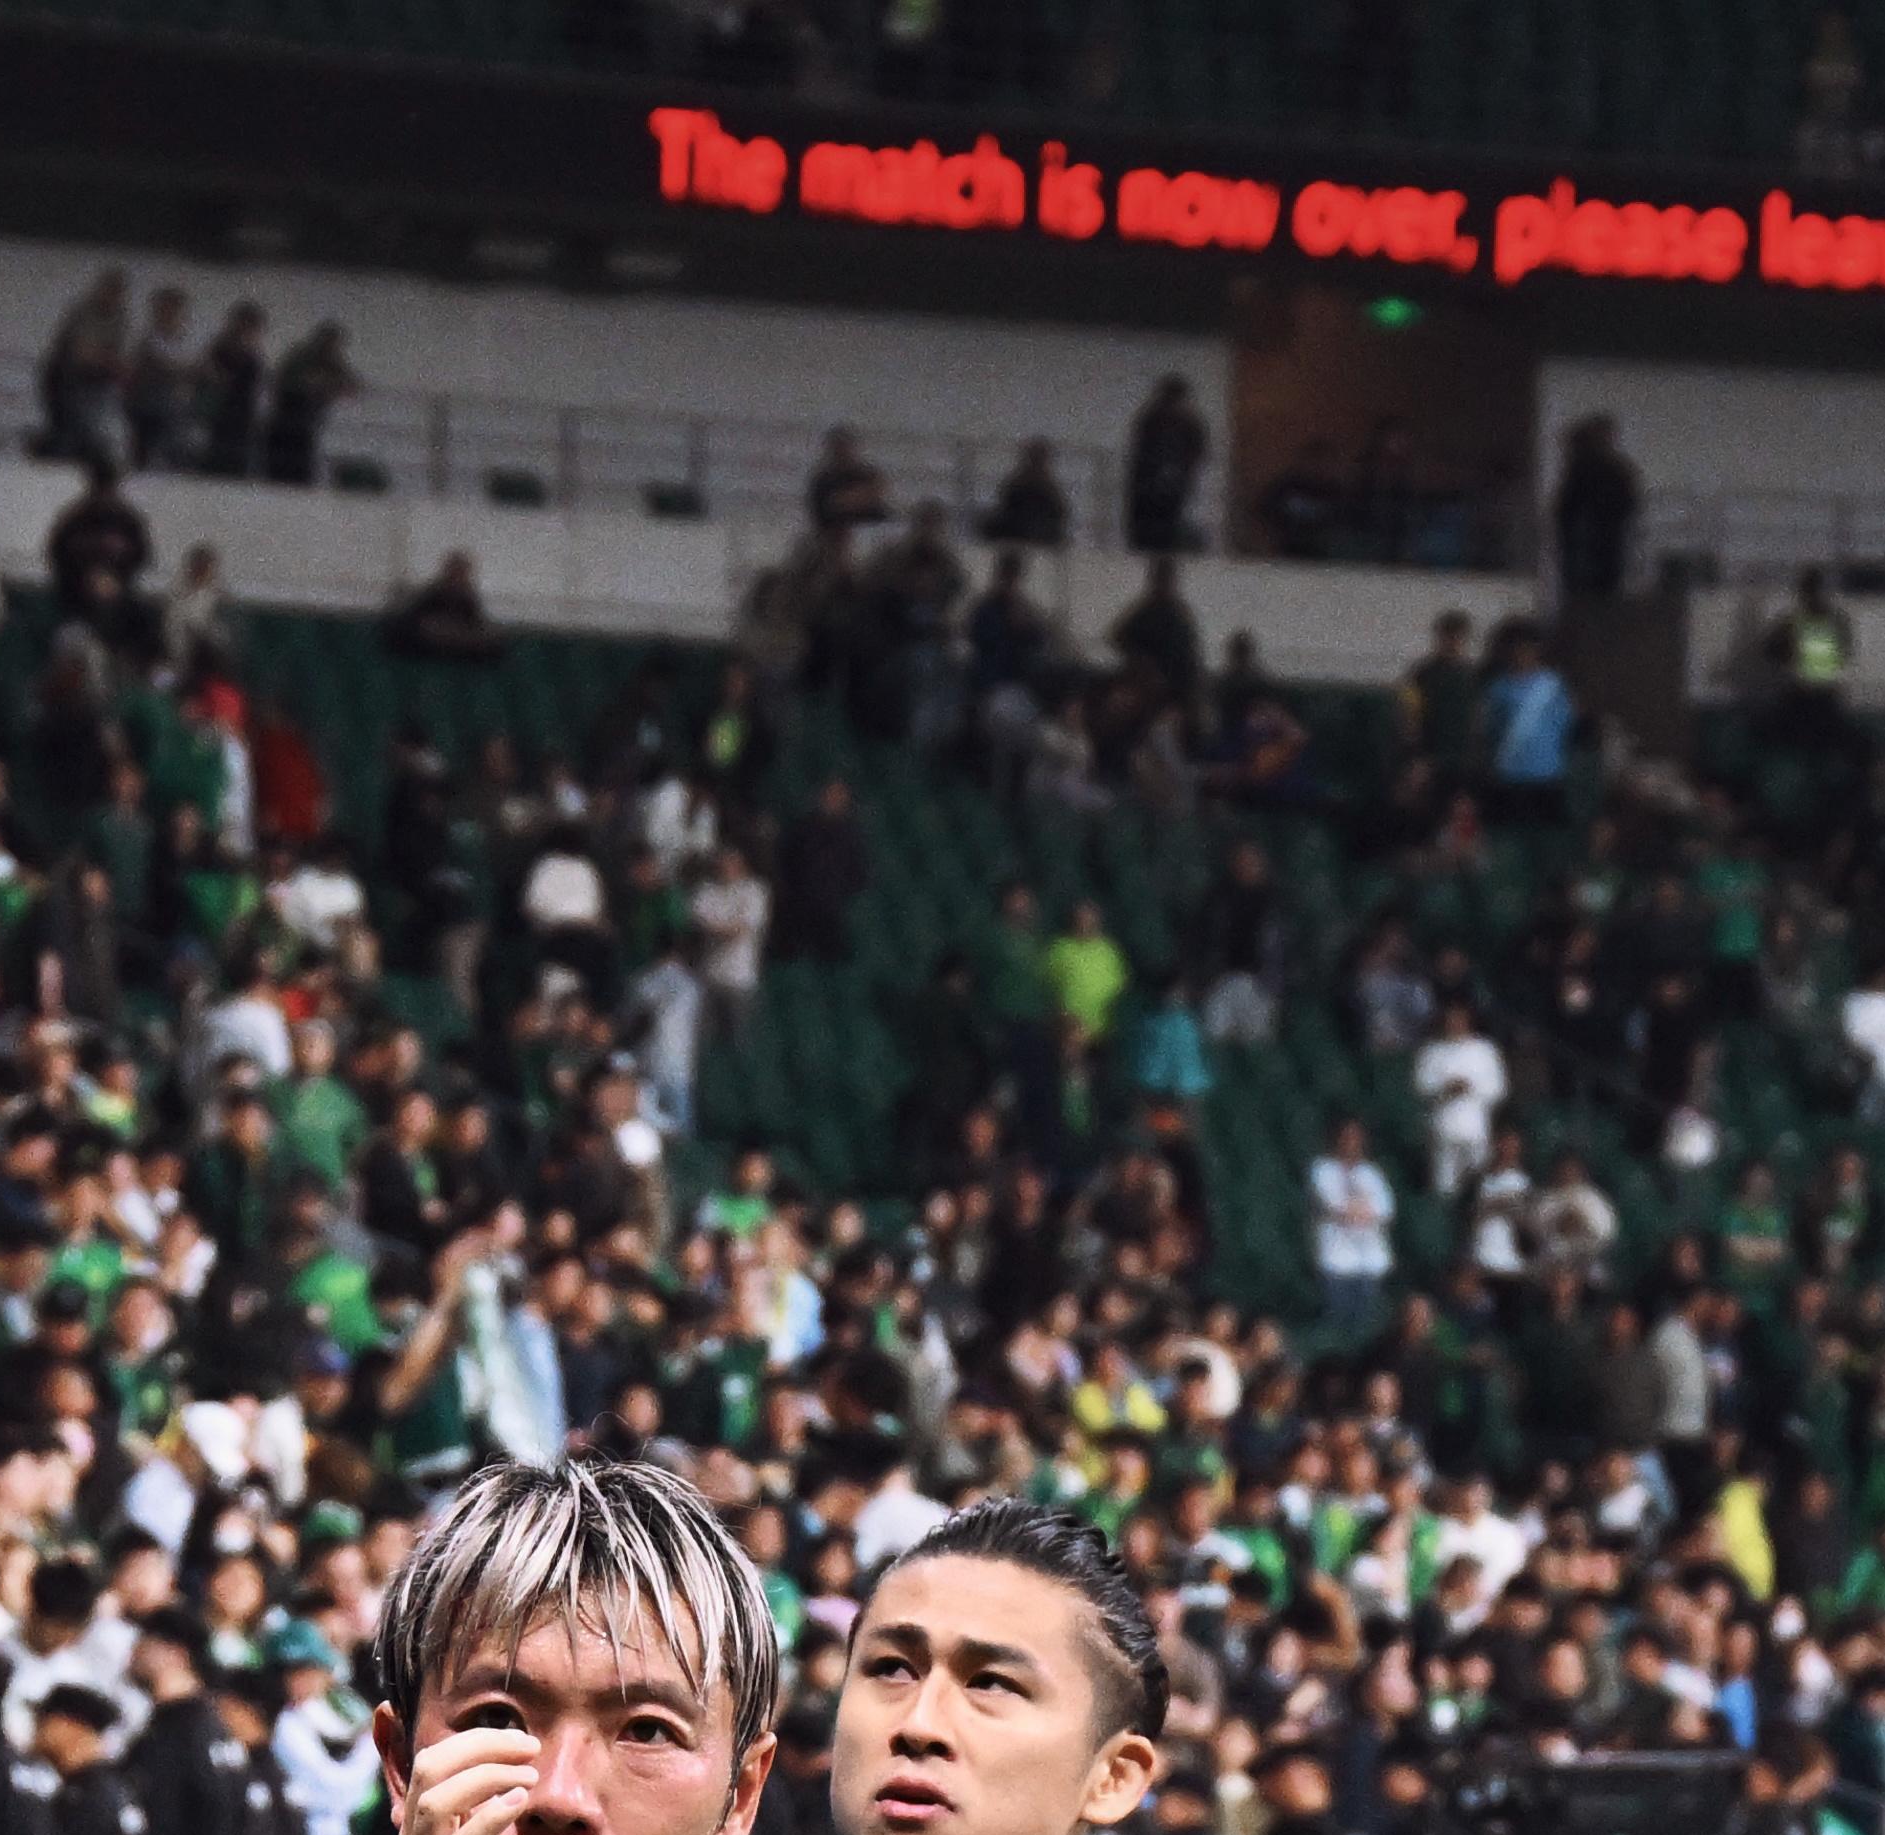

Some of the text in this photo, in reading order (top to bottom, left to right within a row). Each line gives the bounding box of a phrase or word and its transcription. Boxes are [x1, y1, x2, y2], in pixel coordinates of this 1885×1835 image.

[648, 107, 788, 215] The
[800, 133, 1025, 230] match
[1038, 140, 1105, 240] is
[1117, 167, 1281, 252] now
[1292, 180, 1479, 274] over,
[1494, 175, 1748, 287] please
